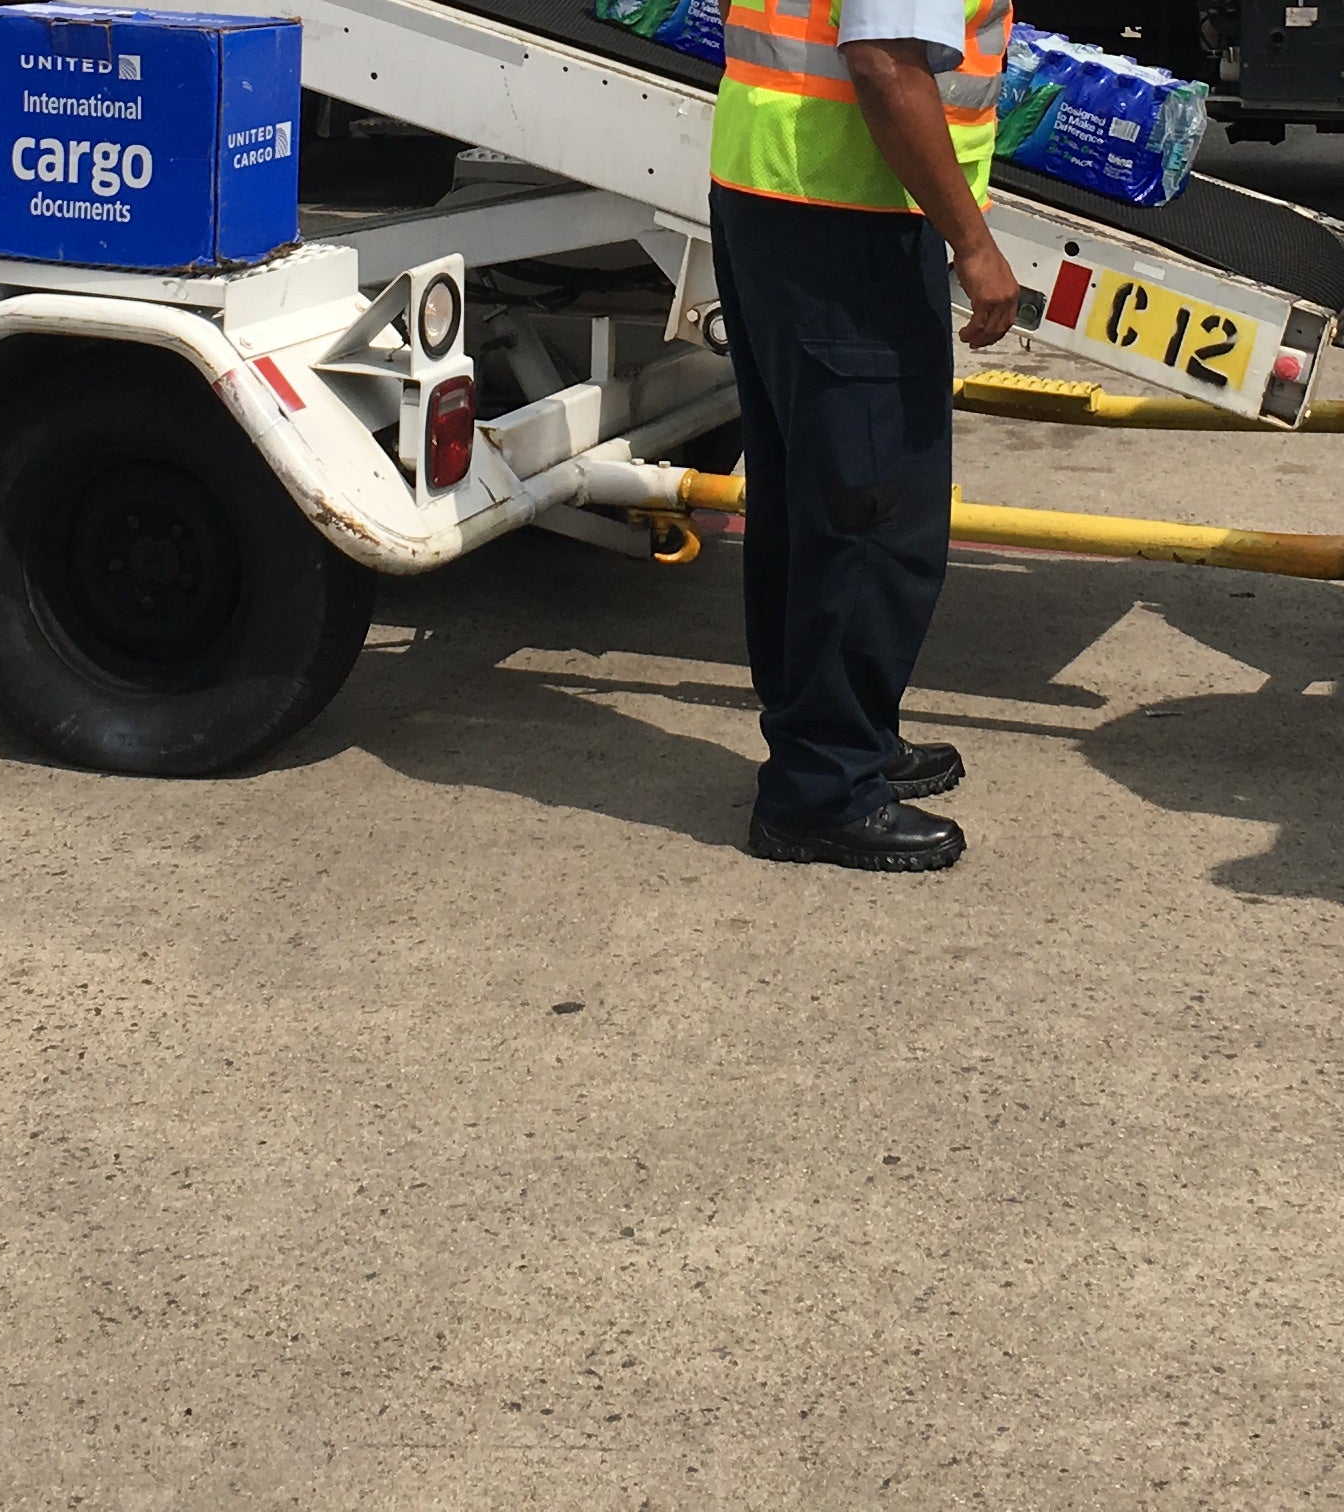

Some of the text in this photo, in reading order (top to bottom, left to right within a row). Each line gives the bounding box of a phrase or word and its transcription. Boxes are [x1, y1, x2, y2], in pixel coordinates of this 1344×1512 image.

[20, 54, 113, 74] UNITED
[23, 90, 143, 120] International
[1060, 101, 1107, 126] Designed
[228, 125, 274, 149] UNITED
[1054, 120, 1105, 145] Difference
[1068, 116, 1096, 134] Make
[12, 136, 154, 197] cargo
[233, 146, 273, 170] CARGO
[30, 191, 132, 223] documents
[1106, 283, 1238, 387] C 12
